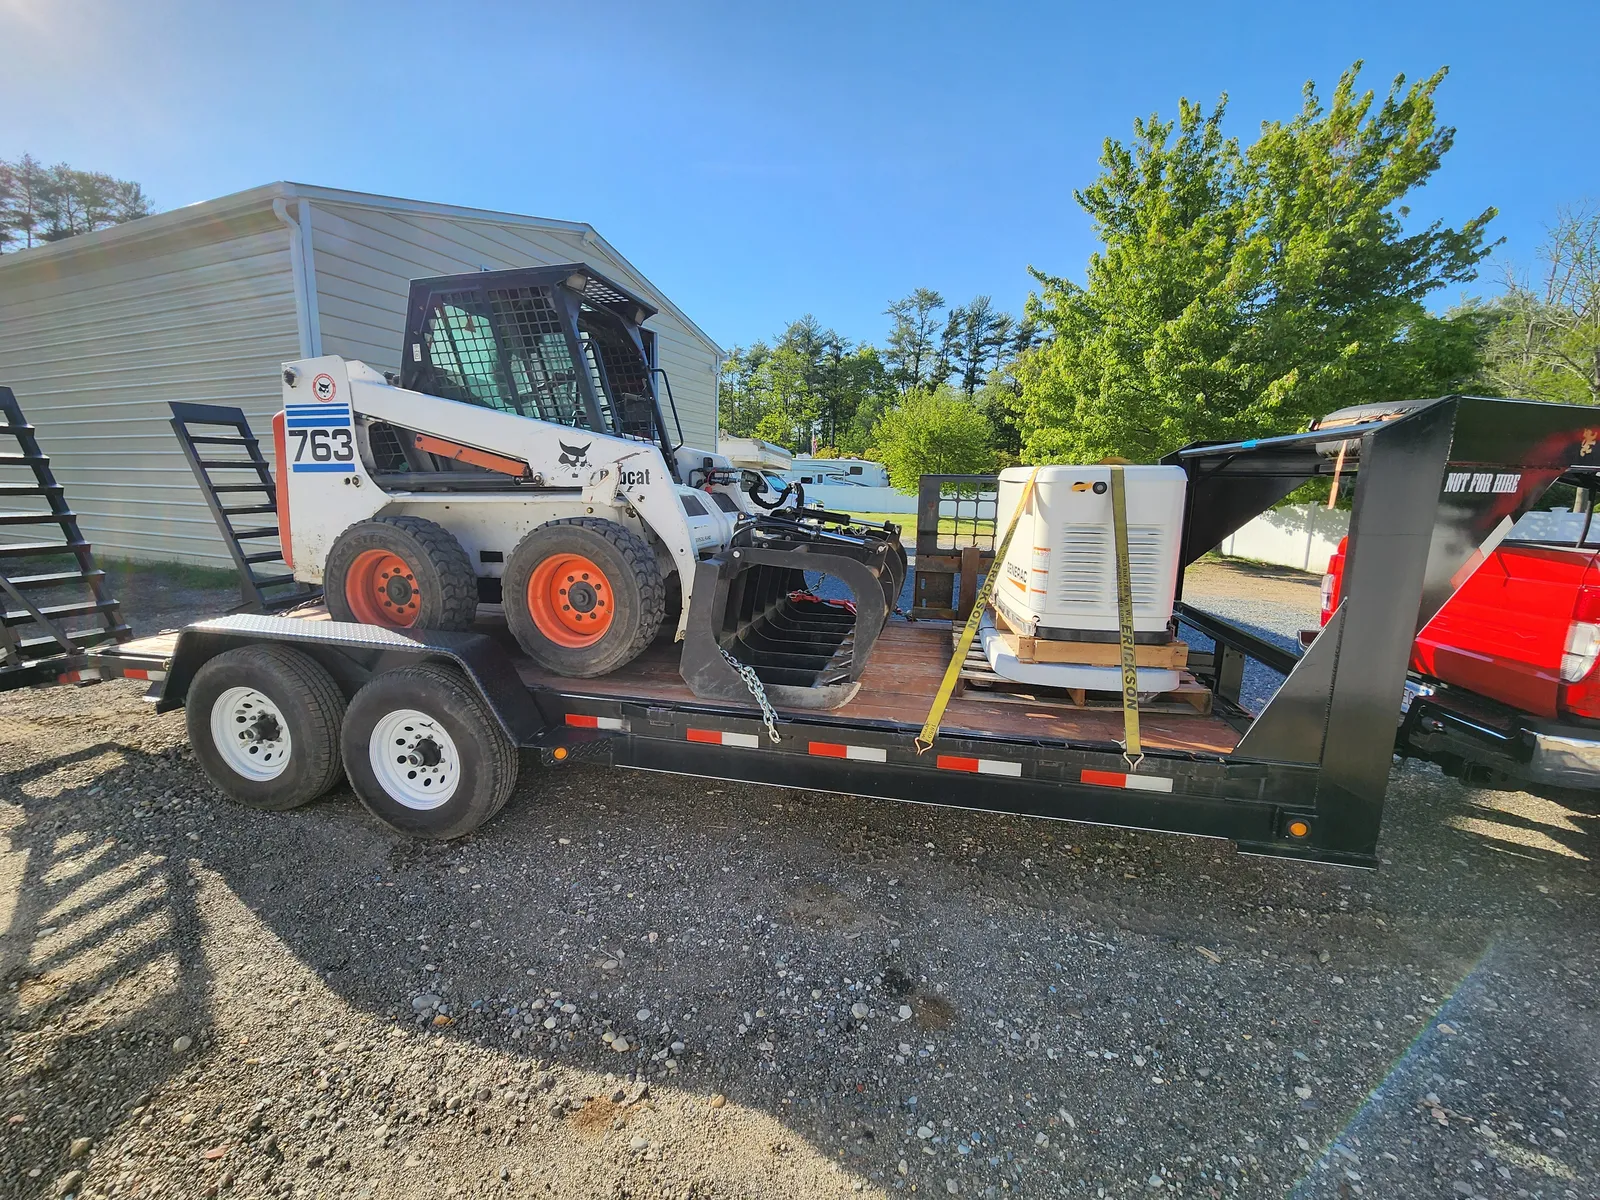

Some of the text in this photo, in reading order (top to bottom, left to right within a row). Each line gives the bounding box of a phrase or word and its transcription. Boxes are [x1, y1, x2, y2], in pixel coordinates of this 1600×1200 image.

[288, 428, 354, 462] 763
[1443, 473, 1522, 493] NOT FOR HIRE
[1007, 561, 1028, 584] GENERAC
[968, 562, 1001, 630] ERICKSON
[1121, 624, 1138, 711] ERICKSON
